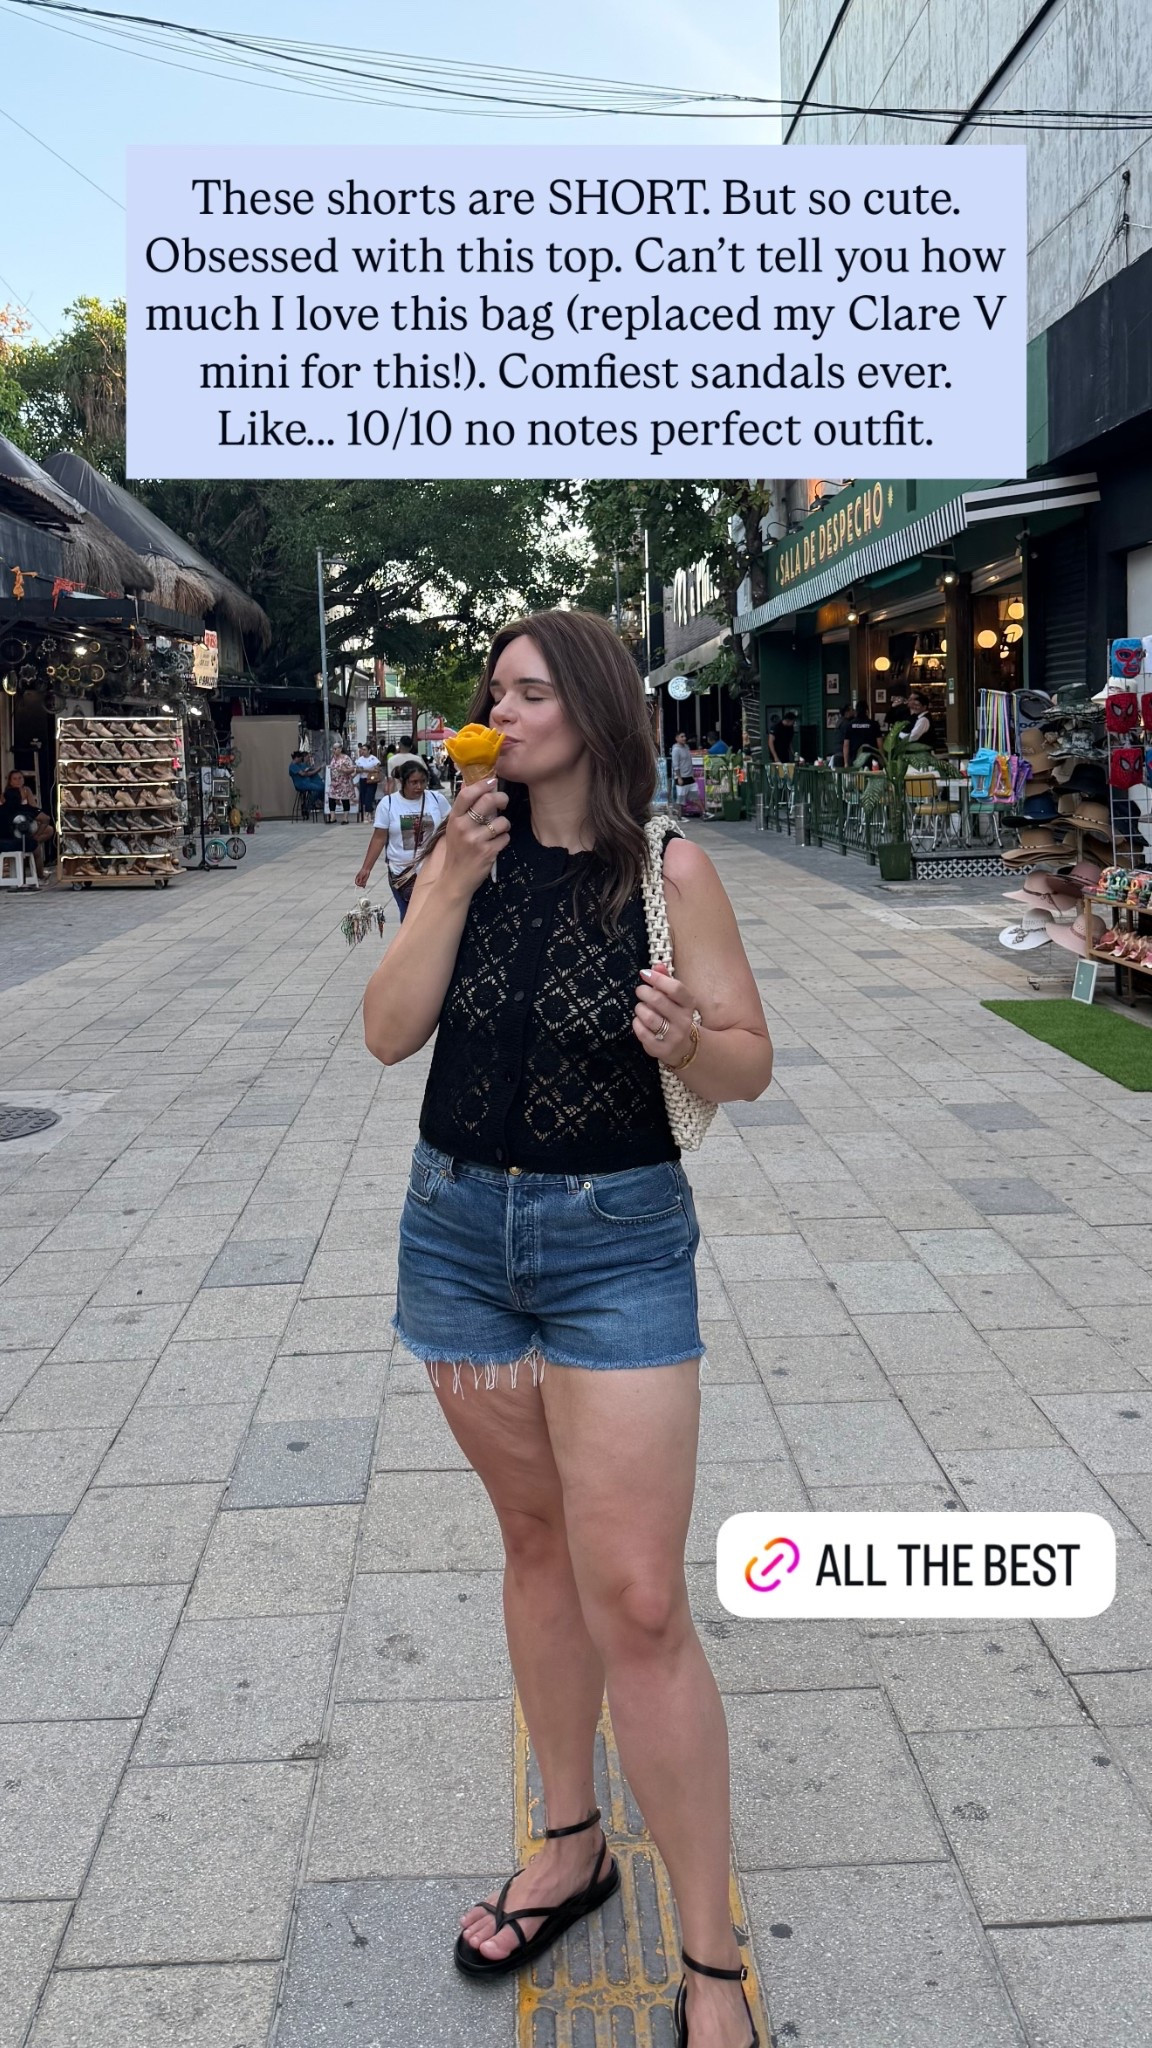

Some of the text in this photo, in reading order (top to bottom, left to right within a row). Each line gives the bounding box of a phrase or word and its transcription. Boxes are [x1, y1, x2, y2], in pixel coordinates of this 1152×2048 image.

[780, 481, 883, 586] SALA DE DESPECHO
